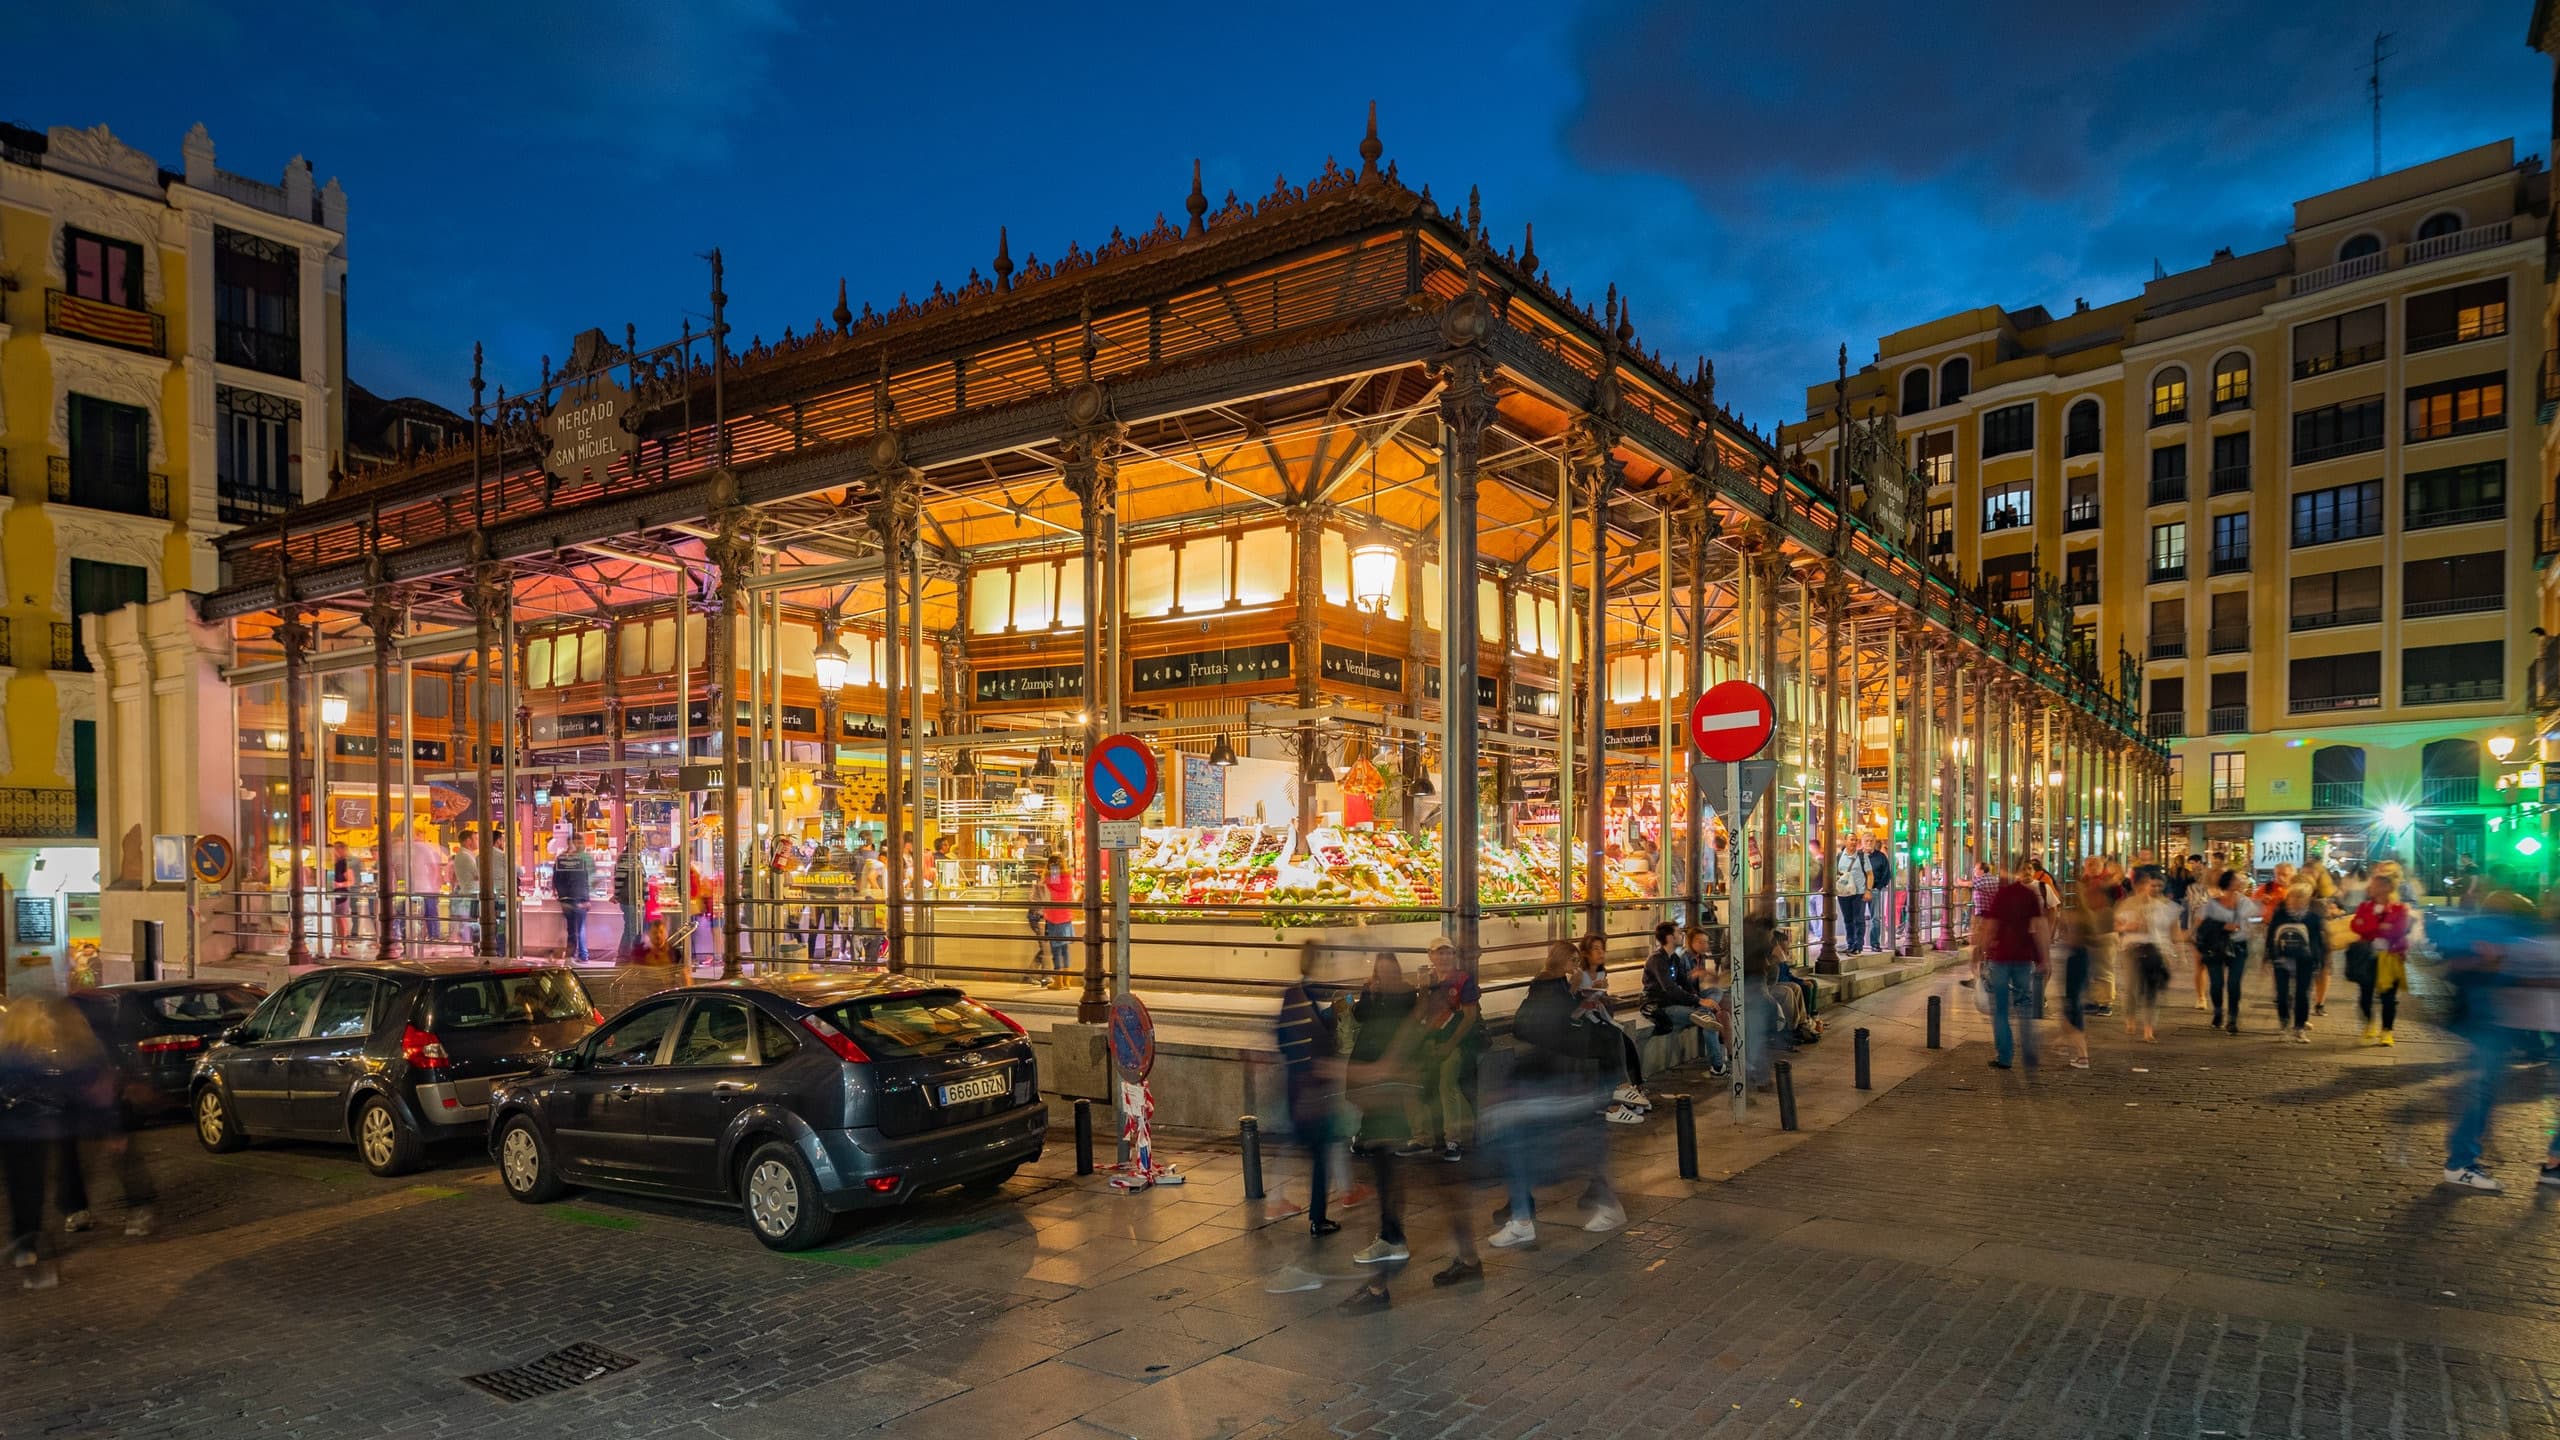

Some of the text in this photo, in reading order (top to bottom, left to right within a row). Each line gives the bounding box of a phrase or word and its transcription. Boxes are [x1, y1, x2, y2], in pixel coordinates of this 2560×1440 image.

[557, 400, 614, 433] MERCADO
[577, 426, 593, 441] DE
[556, 437, 617, 467] SAN MIGUEL
[1879, 476, 1904, 504] MERCADO
[1189, 663, 1229, 677] Frutas
[1344, 658, 1381, 679] Verduras
[1021, 677, 1054, 691] Zumos
[648, 711, 679, 724] Pescader
[1604, 733, 1652, 745] Charcutería
[949, 1077, 1004, 1102] 6660 DZN
